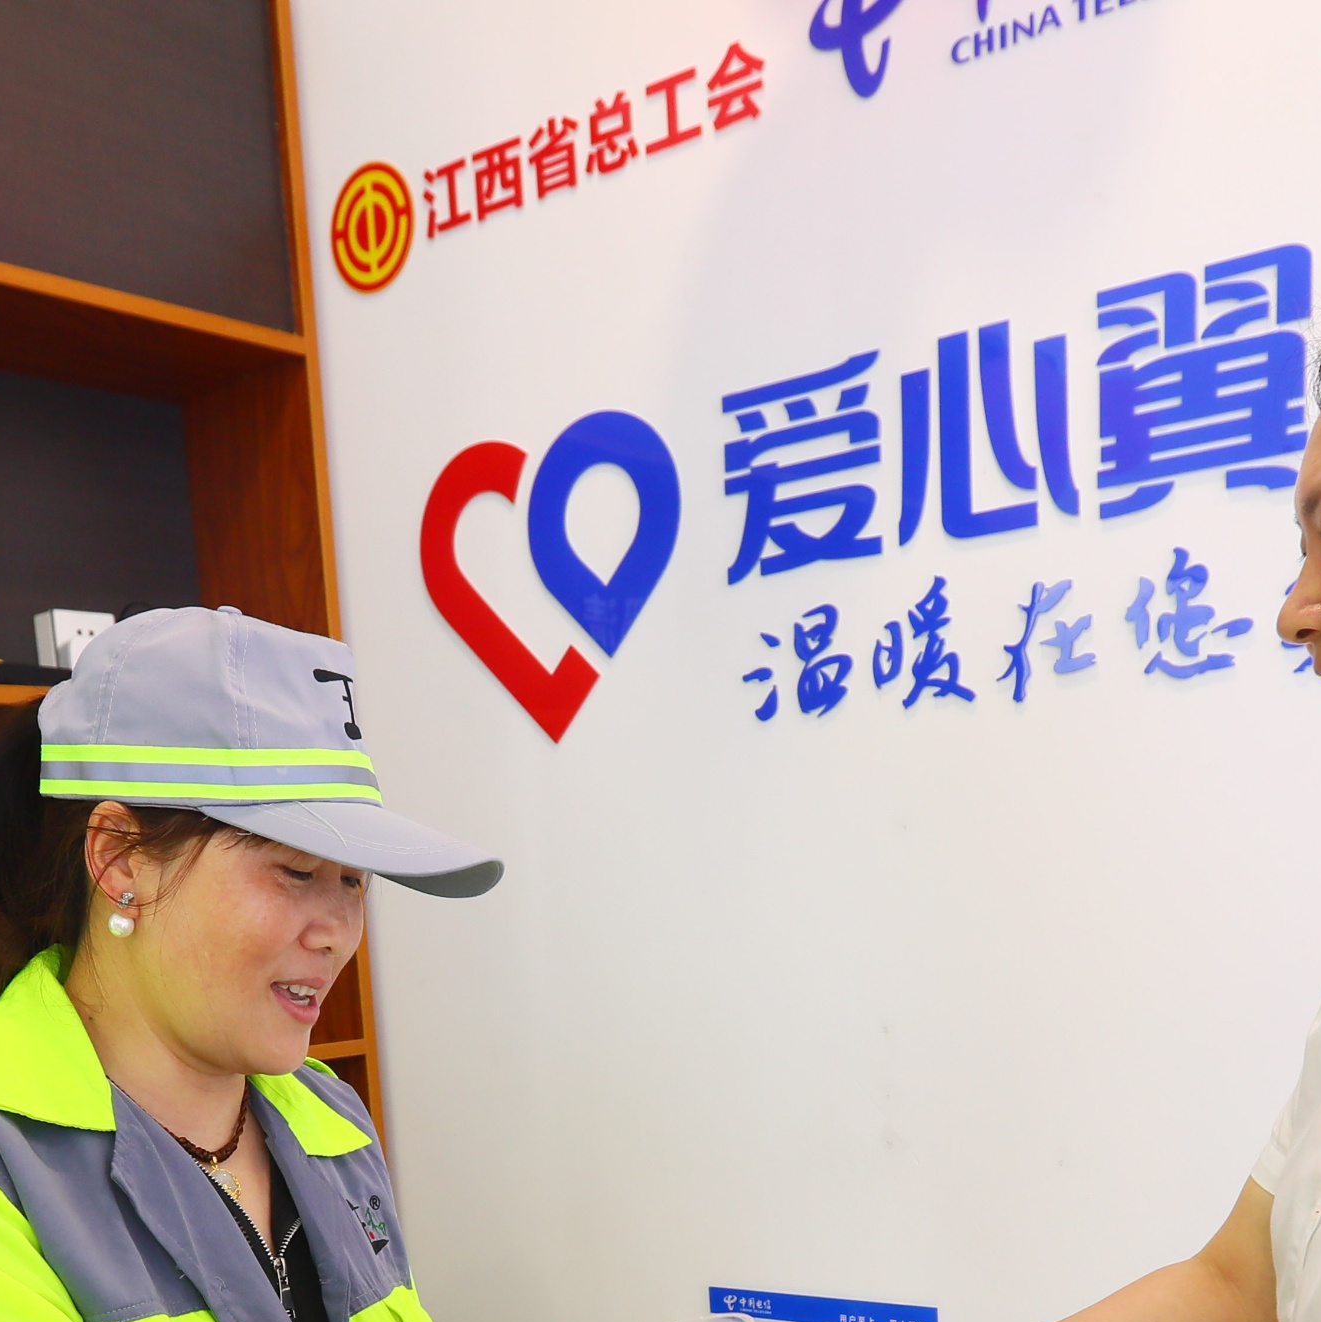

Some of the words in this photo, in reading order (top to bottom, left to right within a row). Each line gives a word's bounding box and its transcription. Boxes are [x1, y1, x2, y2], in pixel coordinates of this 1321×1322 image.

[950, 5, 1061, 64] CHINA
[422, 42, 766, 241] 江西省总工会
[739, 1297, 772, 1311] 中国电信
